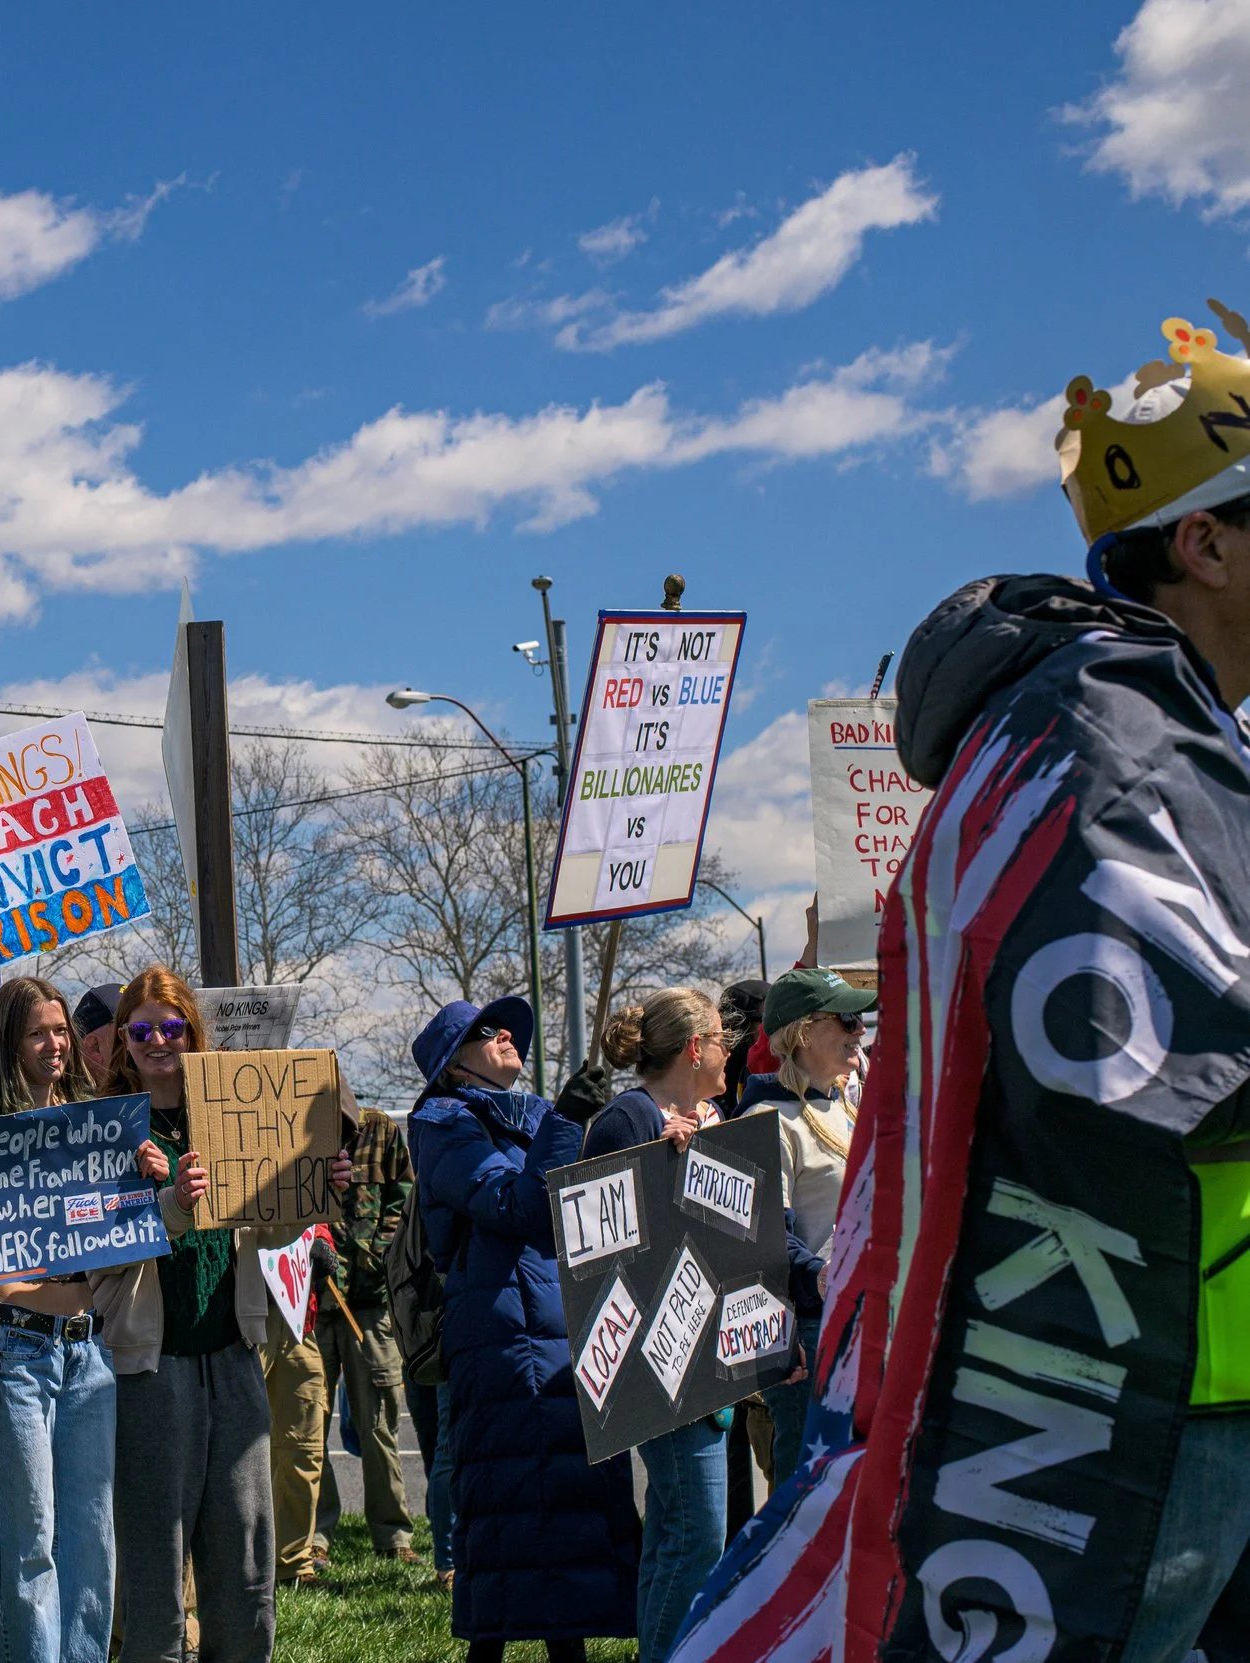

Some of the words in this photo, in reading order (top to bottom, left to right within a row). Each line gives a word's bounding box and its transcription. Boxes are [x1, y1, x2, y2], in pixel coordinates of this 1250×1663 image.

[624, 631, 661, 662] IT'S
[677, 631, 716, 661] NOT
[603, 677, 644, 709] RED
[678, 675, 725, 705] BLUE
[636, 721, 669, 751] IT'S
[830, 722, 869, 744] BAD
[580, 762, 702, 801] BILLIONAIRES
[857, 803, 909, 828] FOR
[855, 834, 915, 854] CHA
[609, 860, 646, 892] YOU
[217, 1003, 234, 1017] NO
[235, 1001, 269, 1017] KINGS
[202, 1057, 324, 1104] LOVE
[67, 1110, 122, 1145] who
[222, 1111, 297, 1152] THY
[29, 1159, 86, 1190] Frank
[88, 1148, 138, 1183] BROK
[19, 1193, 61, 1219] her
[66, 1197, 98, 1211] Fuck
[120, 1197, 154, 1208] AMERICA
[195, 1156, 342, 1226] NEIGHBOR
[687, 1160, 754, 1218] PATRIOTIC
[71, 1208, 99, 1219] ICE
[562, 1190, 593, 1258] I
[46, 1218, 137, 1261] followed
[648, 1312, 677, 1376] NOT
[669, 1259, 701, 1325] PAID
[727, 1291, 768, 1322] DEFENDING
[581, 1300, 637, 1399] LOCAL
[672, 1355, 684, 1376] TO
[680, 1336, 692, 1356] BE
[690, 1299, 707, 1335] HERE
[719, 1310, 787, 1359] DEMOCRACY!
[916, 1176, 1147, 1663] KING
